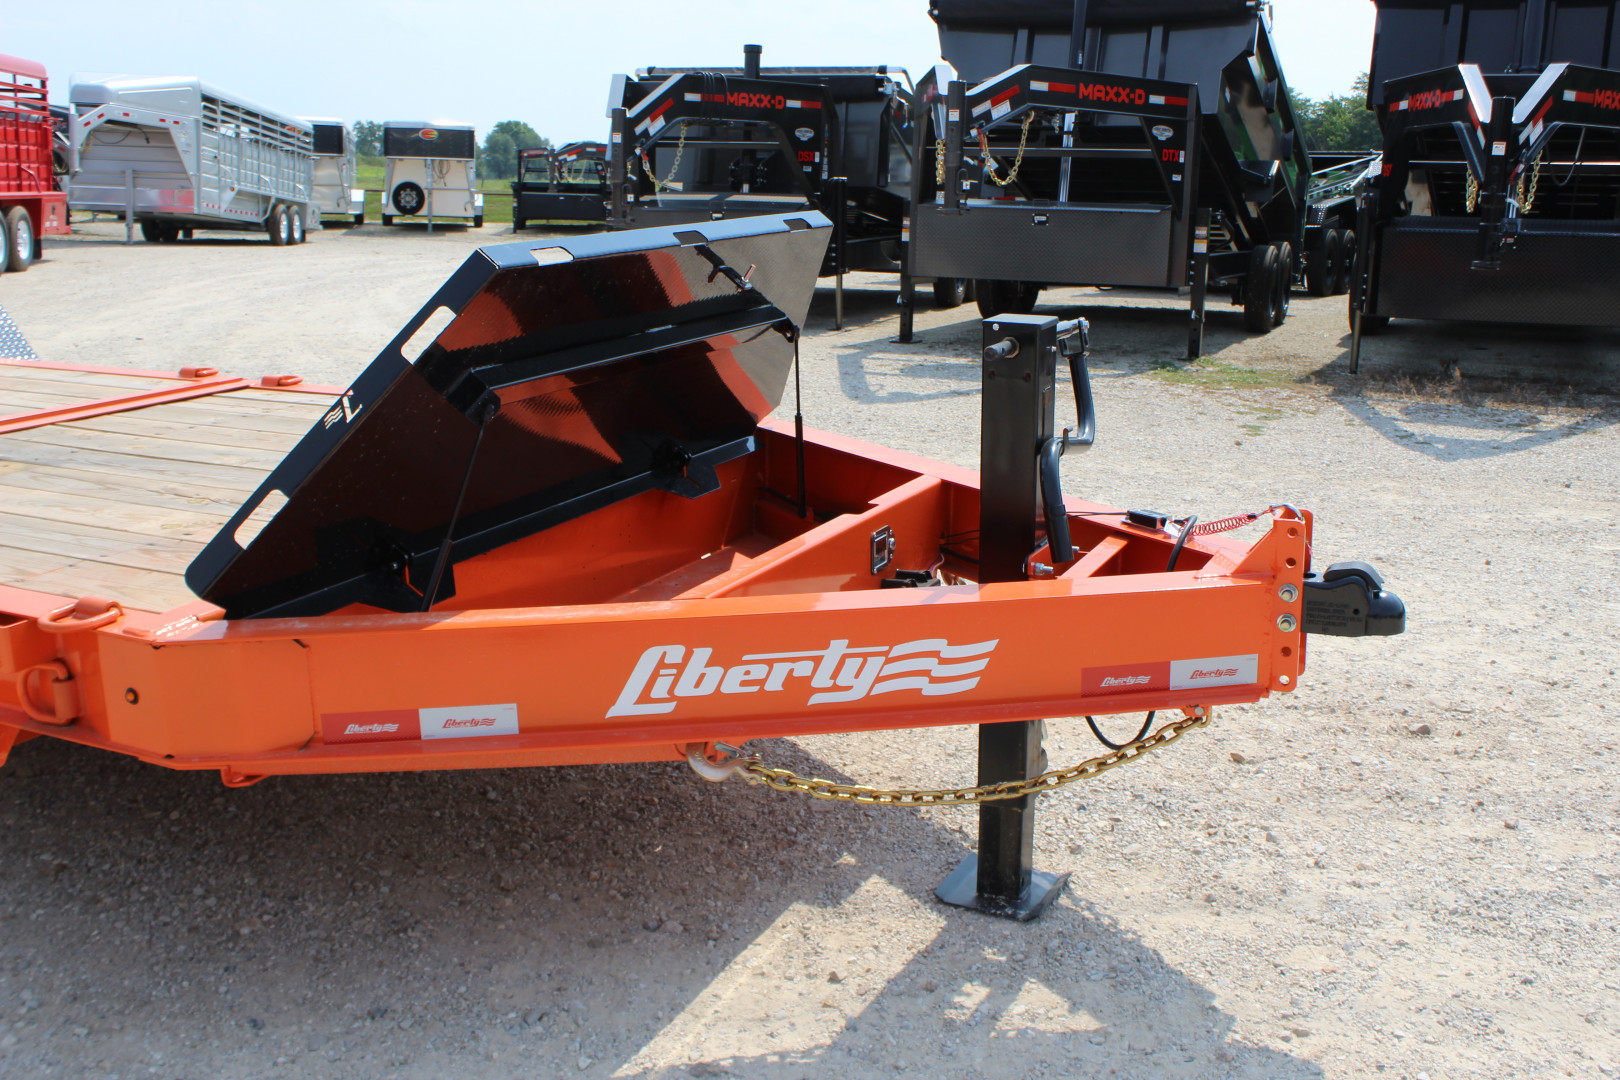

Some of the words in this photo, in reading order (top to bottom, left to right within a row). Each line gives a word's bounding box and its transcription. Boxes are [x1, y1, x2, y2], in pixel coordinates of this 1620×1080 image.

[1079, 83, 1146, 105] MAXX-D
[726, 92, 785, 109] MAXX-D
[1408, 89, 1441, 112] MAXX-D
[1162, 149, 1179, 161] DTX
[605, 639, 890, 719] Liberty
[1189, 668, 1224, 679] Liberty
[1100, 676, 1136, 687] Liberty
[344, 723, 383, 735] Liberty
[442, 718, 480, 729] Liberty
